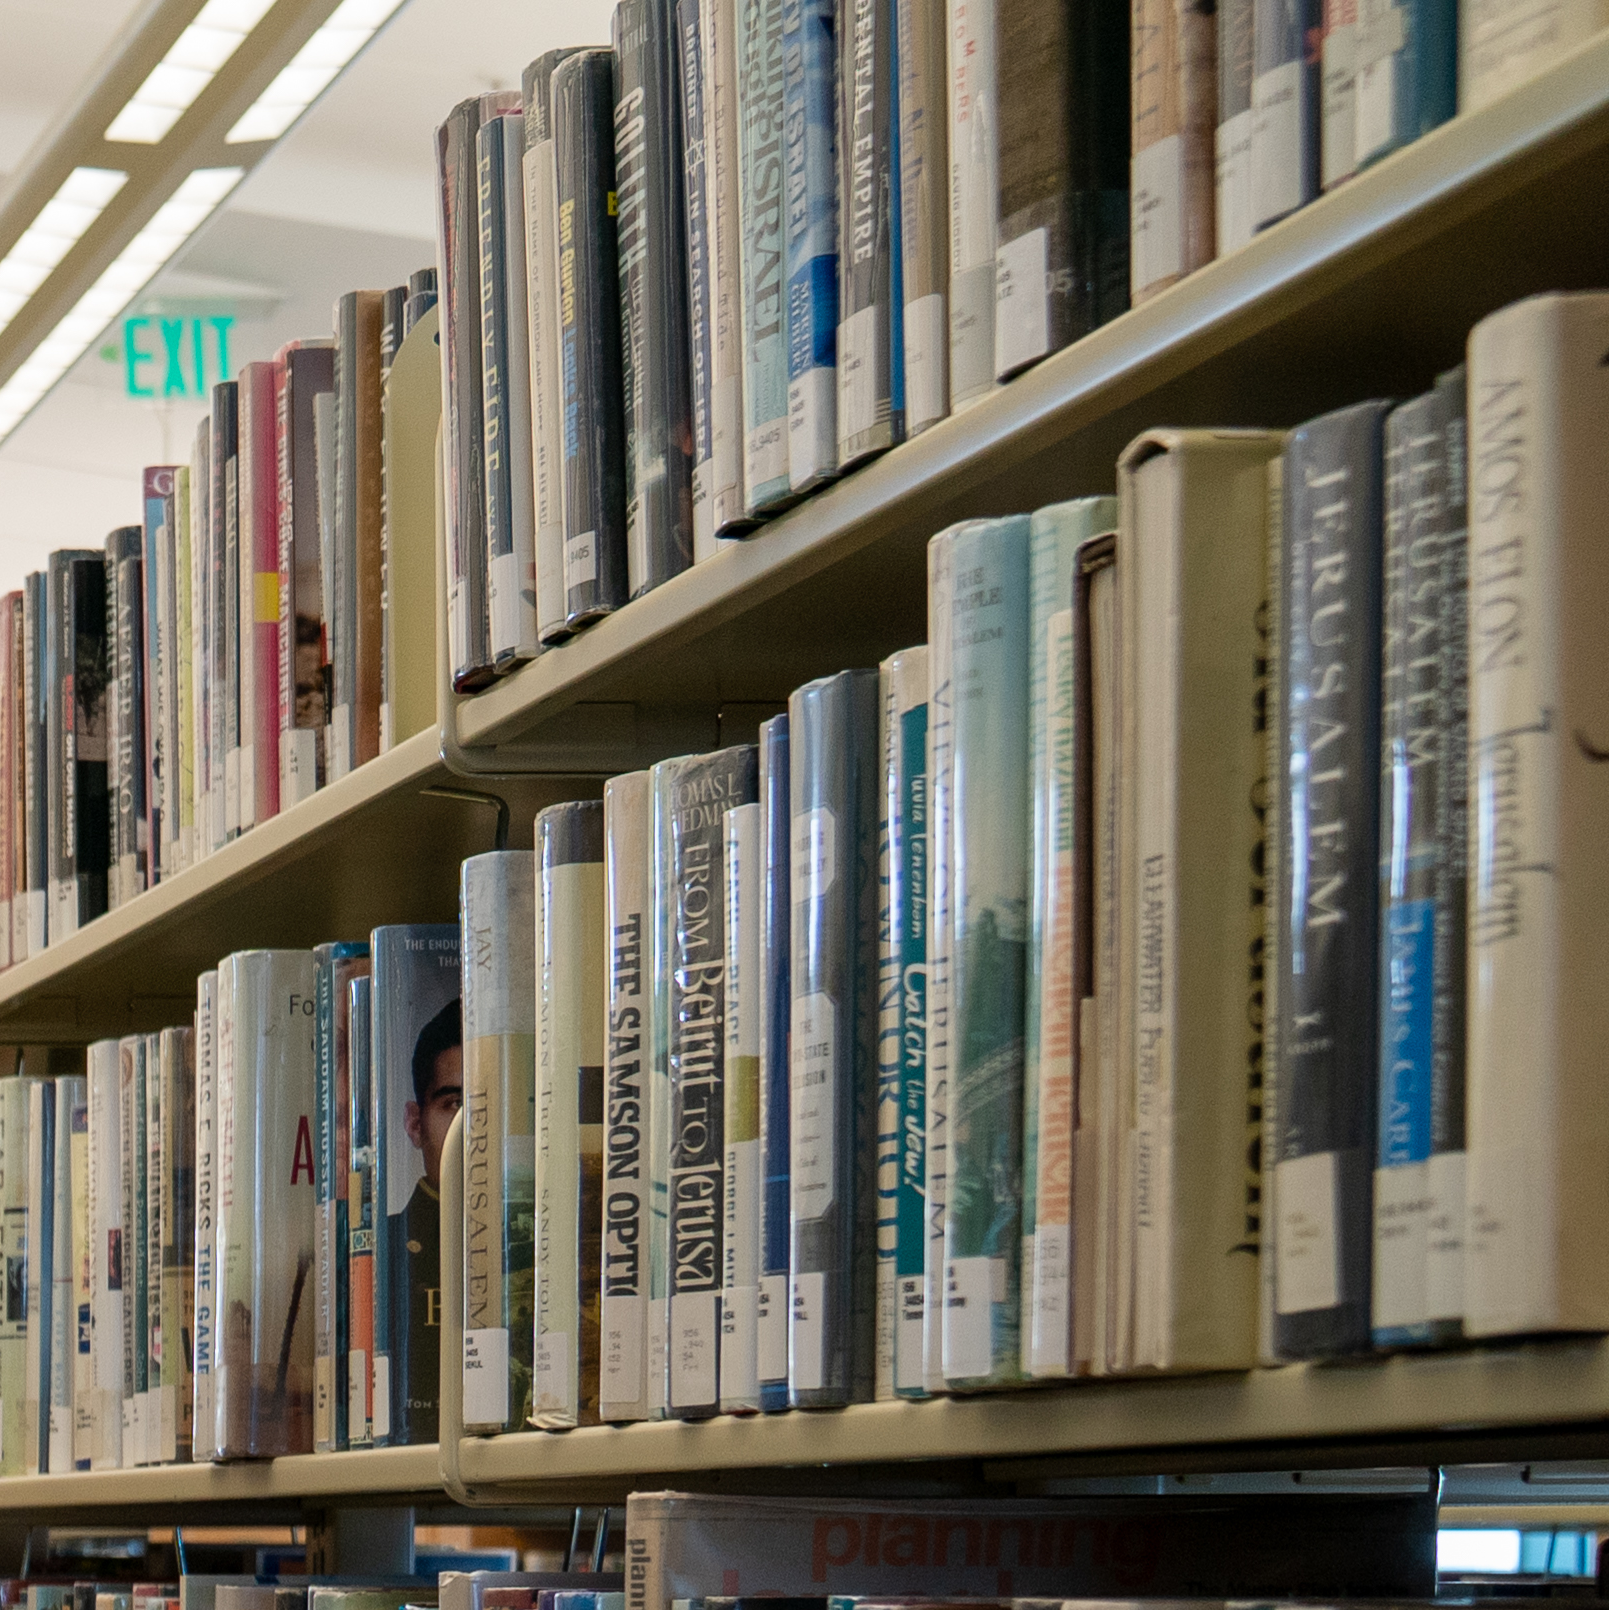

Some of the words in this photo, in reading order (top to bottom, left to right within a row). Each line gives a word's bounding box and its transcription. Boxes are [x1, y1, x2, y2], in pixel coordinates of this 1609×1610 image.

[685, 23, 697, 120] BRENNER
[614, 86, 648, 280] GOLIATH
[690, 191, 699, 219] IN
[852, 133, 873, 265] EMPIRE
[692, 227, 703, 338] SEARCH
[752, 135, 782, 362] ISRAEL
[123, 315, 235, 398] EXIT
[695, 351, 704, 379] OF
[790, 284, 802, 380] GILBERT
[799, 281, 811, 368] MARTIN
[1476, 379, 1526, 524] AMOS
[1407, 429, 1442, 770] JERUSALEM
[1476, 536, 1525, 673] ELON
[117, 604, 131, 715] AFTER
[1304, 466, 1351, 930] JERUSALEM
[117, 733, 131, 814] IRAQ
[909, 832, 926, 940] Tenenbom
[475, 926, 491, 970] JAY
[607, 912, 642, 996] THE
[199, 996, 212, 1103] THOMAS
[607, 1006, 641, 1178] SAMSON
[199, 1152, 211, 1229] RICKS
[198, 1243, 211, 1297] THE
[198, 1305, 211, 1376] GAME
